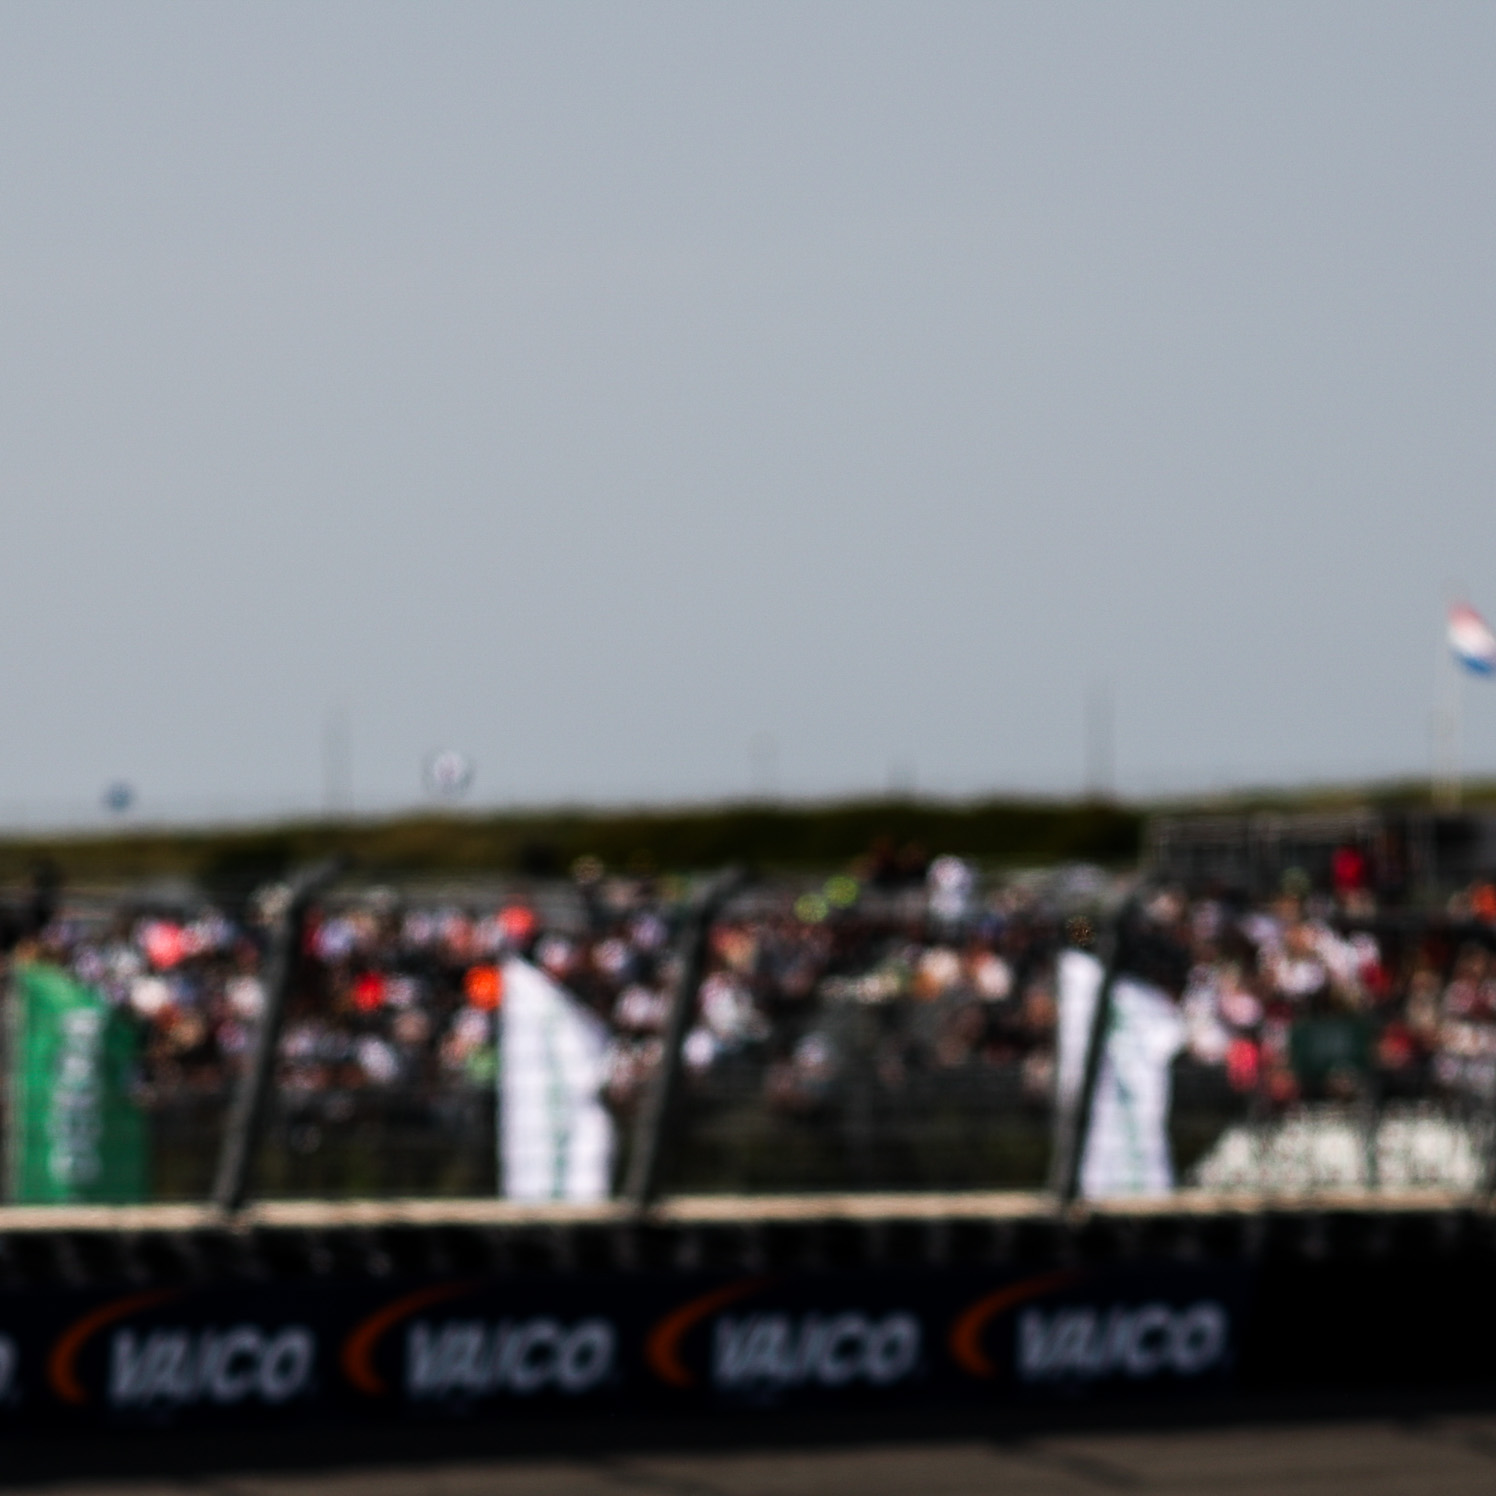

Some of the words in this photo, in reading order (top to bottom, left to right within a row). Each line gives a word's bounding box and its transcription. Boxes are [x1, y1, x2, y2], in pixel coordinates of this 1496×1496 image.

[109, 1325, 314, 1402] VAICO
[409, 1318, 610, 1393] VAICO
[715, 1313, 916, 1384] VAICO
[1020, 1303, 1226, 1374] VAICO
